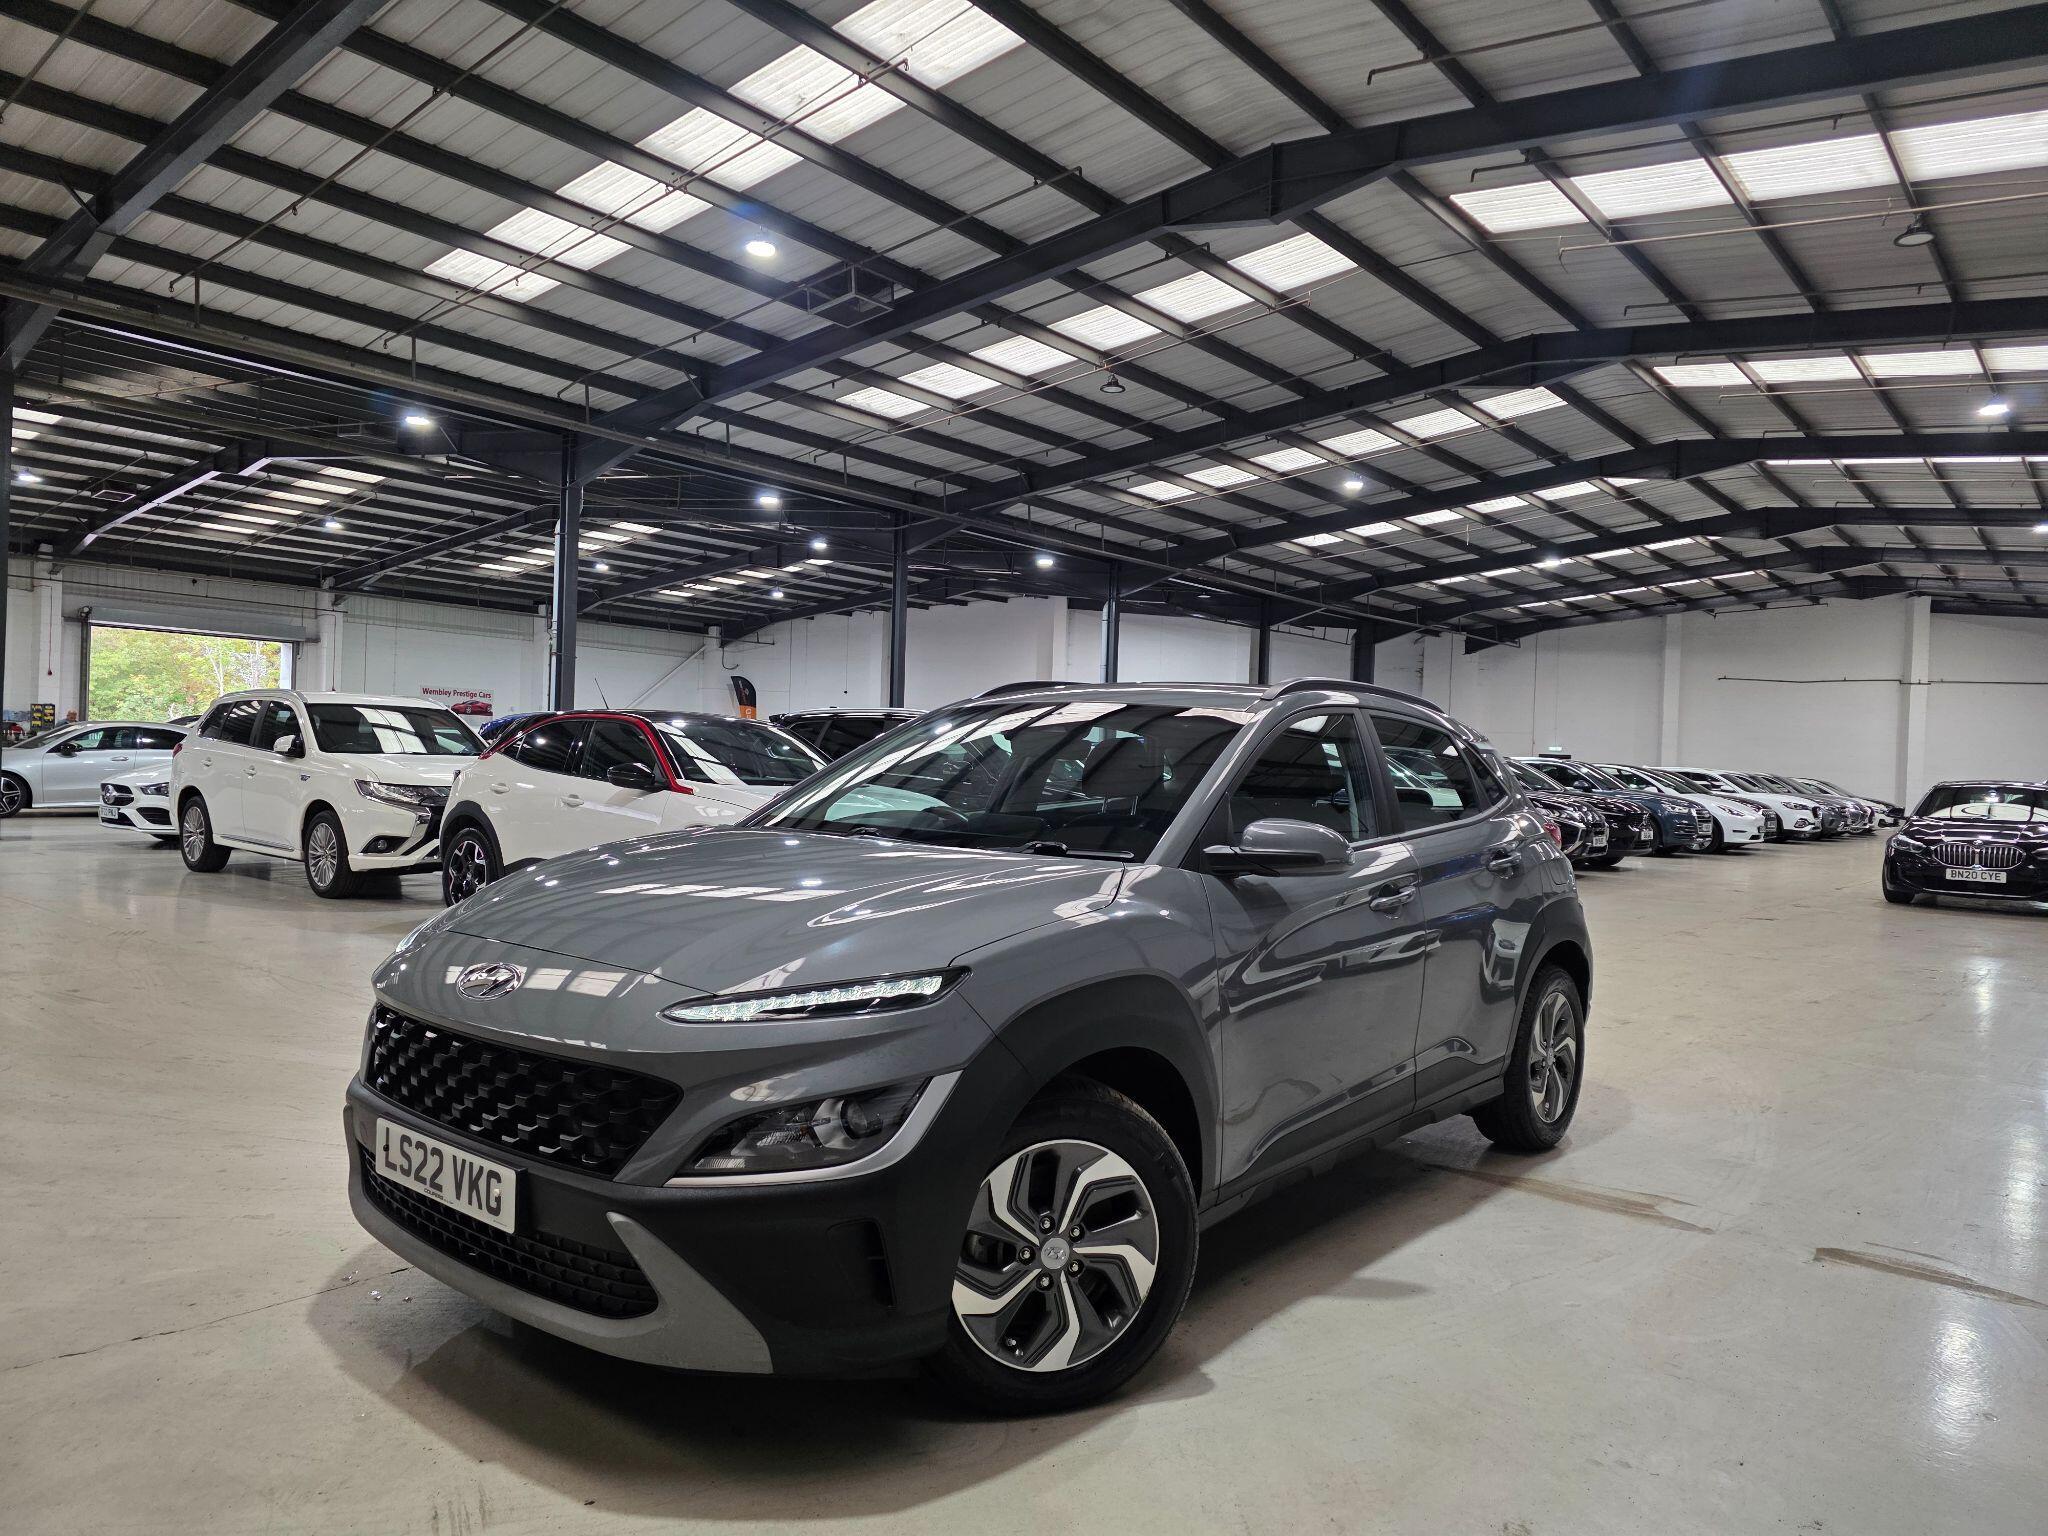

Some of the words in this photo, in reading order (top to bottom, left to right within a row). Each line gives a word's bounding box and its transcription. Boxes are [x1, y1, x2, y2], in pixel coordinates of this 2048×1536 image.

[422, 687, 452, 697] Wembley
[453, 689, 478, 699] Prestige
[478, 691, 492, 699] Cars
[1950, 869, 1978, 880] BN20
[1980, 871, 2002, 881] CYE
[384, 1126, 444, 1193] LS22
[452, 1155, 503, 1217] VKG
